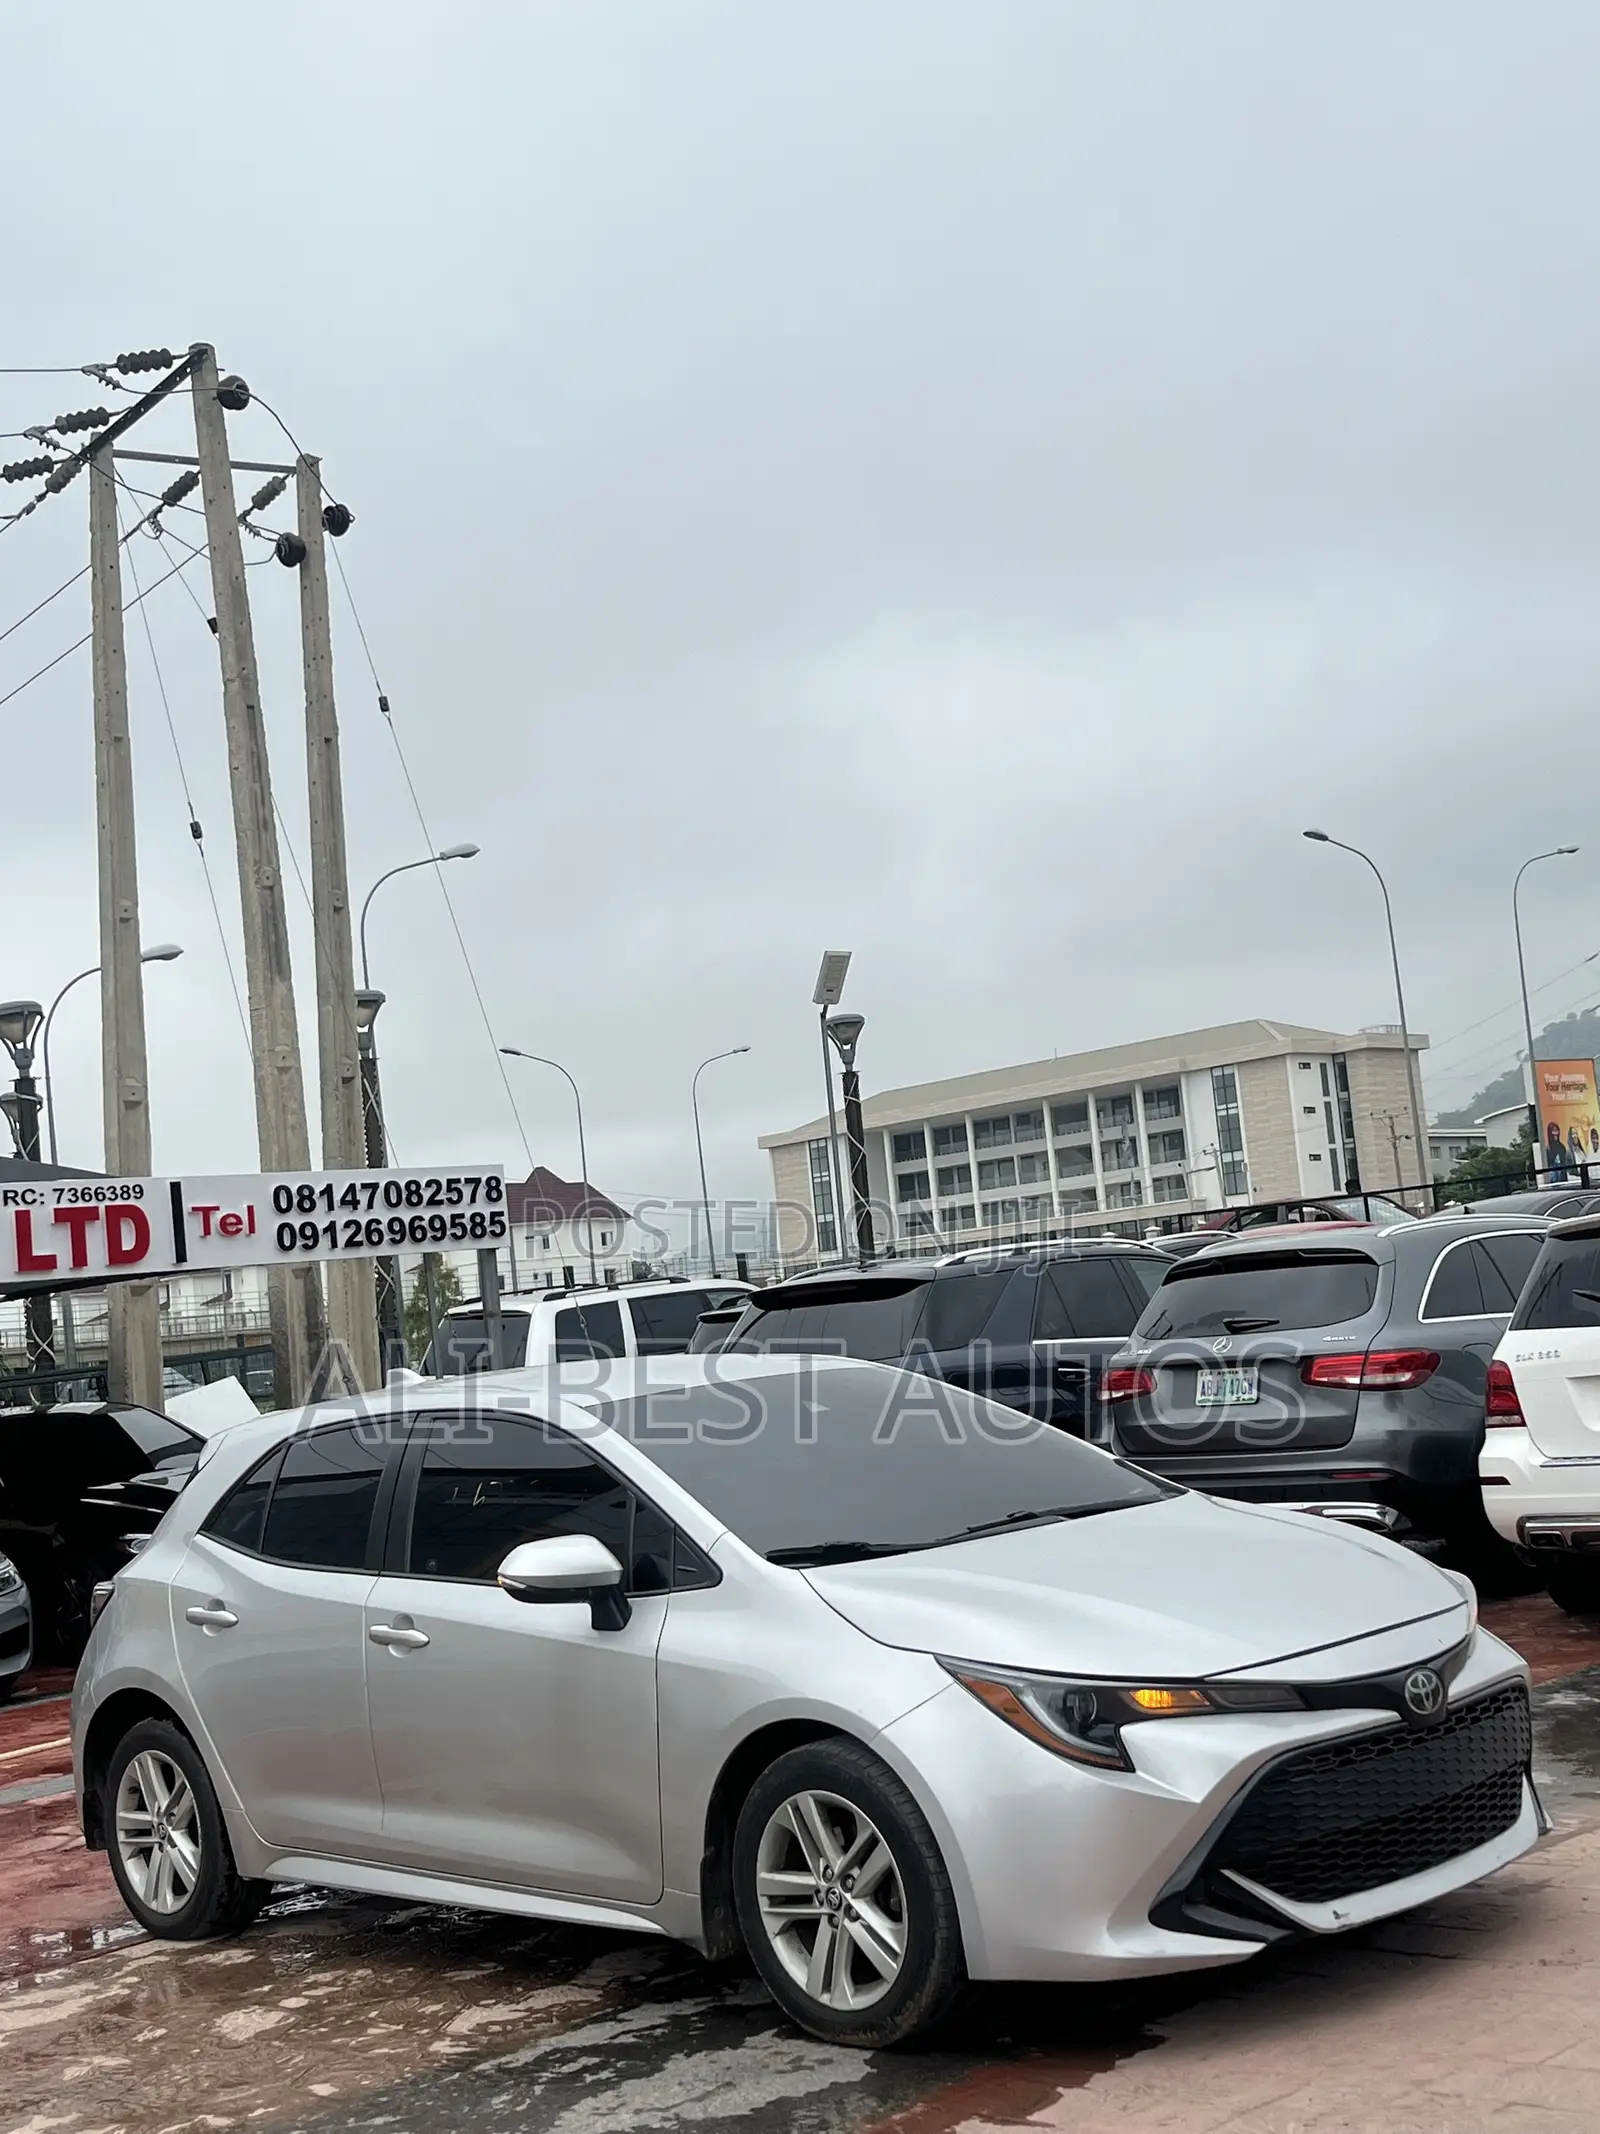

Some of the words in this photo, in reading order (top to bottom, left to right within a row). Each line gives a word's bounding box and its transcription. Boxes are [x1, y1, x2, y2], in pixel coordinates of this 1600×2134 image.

[2, 1188, 46, 1207] RC:
[52, 1184, 145, 1205] 7366389
[190, 1204, 256, 1238] Tel
[272, 1175, 504, 1215] 08147082578
[13, 1203, 151, 1273] LTD
[275, 1210, 507, 1252] 09126969585
